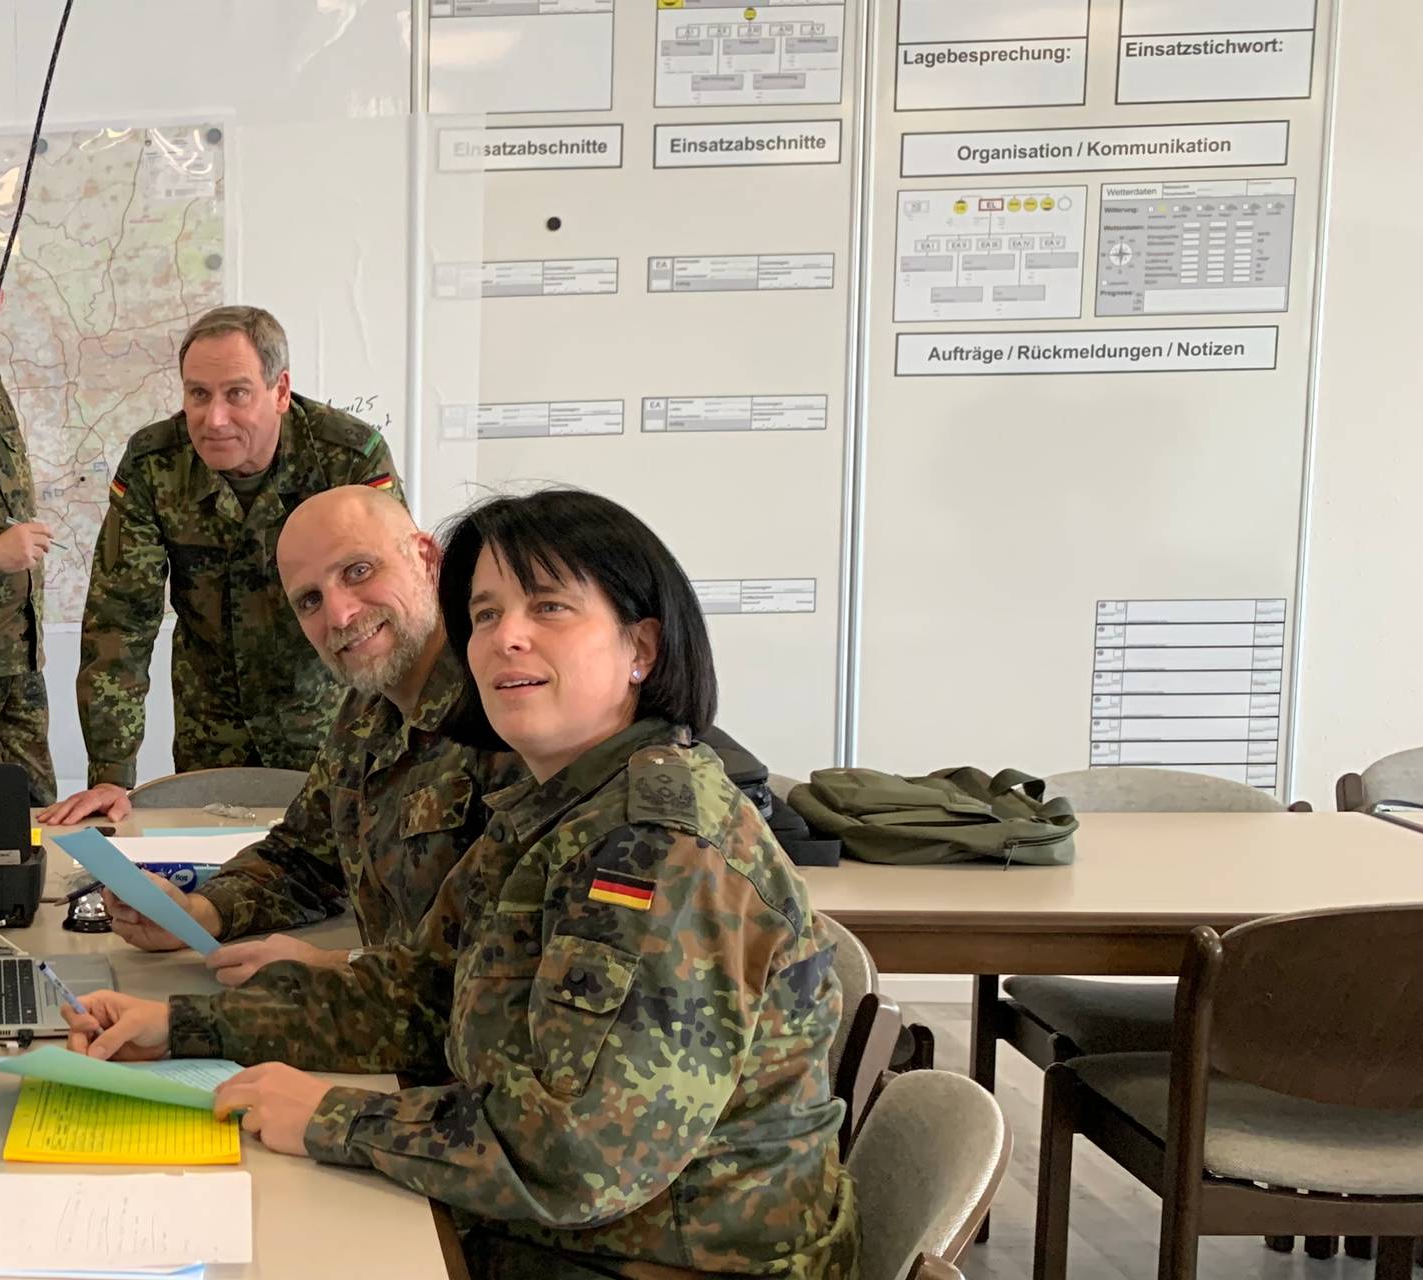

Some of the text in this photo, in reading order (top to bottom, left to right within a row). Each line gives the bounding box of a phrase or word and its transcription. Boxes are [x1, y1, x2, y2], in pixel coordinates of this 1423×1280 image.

[902, 45, 1072, 68] Lagebesprechung:
[1125, 38, 1285, 58] Einsatzstichwort:
[453, 139, 608, 158] Einsatzabschnitte
[669, 135, 827, 154] Einsatzabschnitte
[956, 143, 1073, 164] Organisation
[1086, 137, 1232, 157] Kommunikation
[1106, 188, 1158, 197] Wetterdaten
[927, 346, 1004, 365] Aufträge
[1017, 343, 1163, 362] Rückmeldungen
[1176, 341, 1245, 358] Notizen
